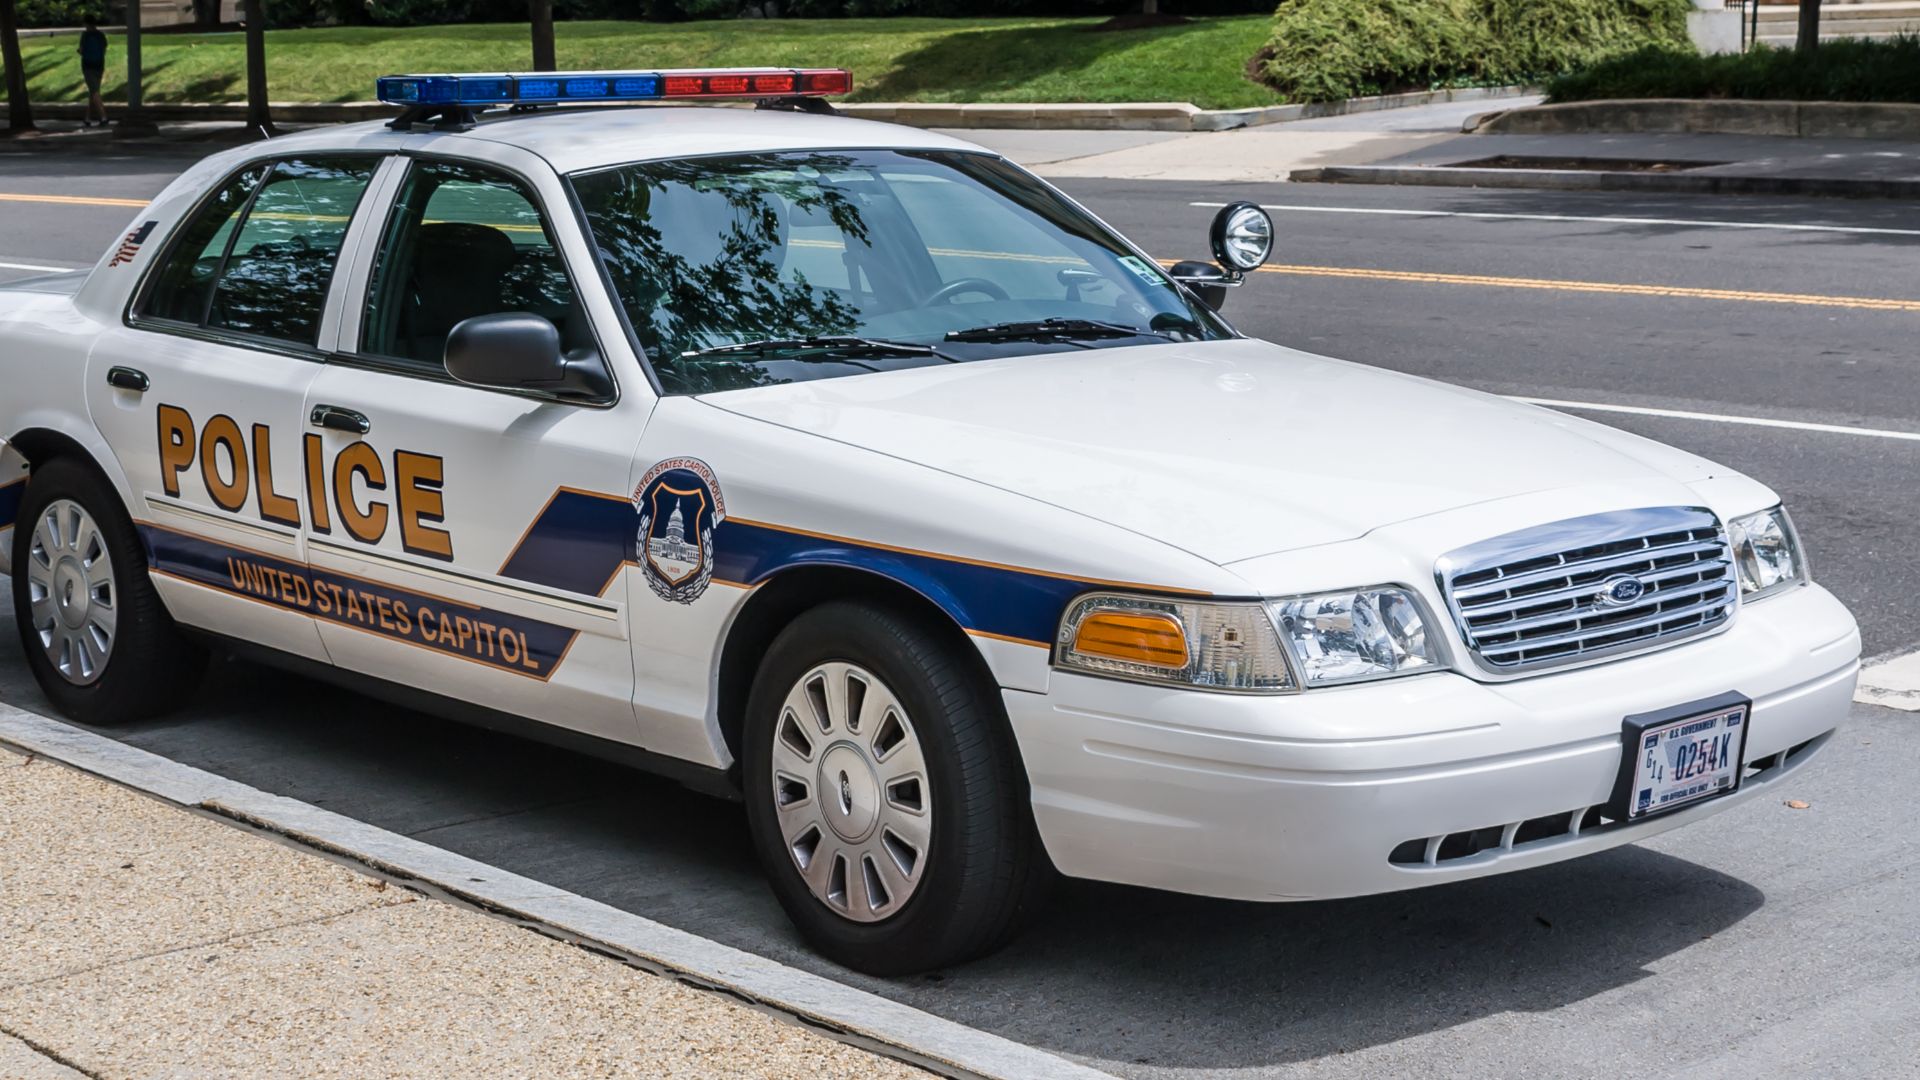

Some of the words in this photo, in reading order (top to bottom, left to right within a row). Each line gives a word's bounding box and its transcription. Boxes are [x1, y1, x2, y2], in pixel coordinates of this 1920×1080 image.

[157, 403, 453, 562] POLICE
[633, 471, 654, 503] UNITED
[655, 459, 683, 475] STATES
[684, 459, 711, 482] CAPITOL
[709, 480, 724, 516] POLICE
[227, 556, 312, 608] UNITED
[313, 579, 412, 635] STATES
[417, 607, 539, 669] CAPITOL
[1680, 718, 1718, 736] GOVERNMENT
[1675, 732, 1732, 781] 0254K
